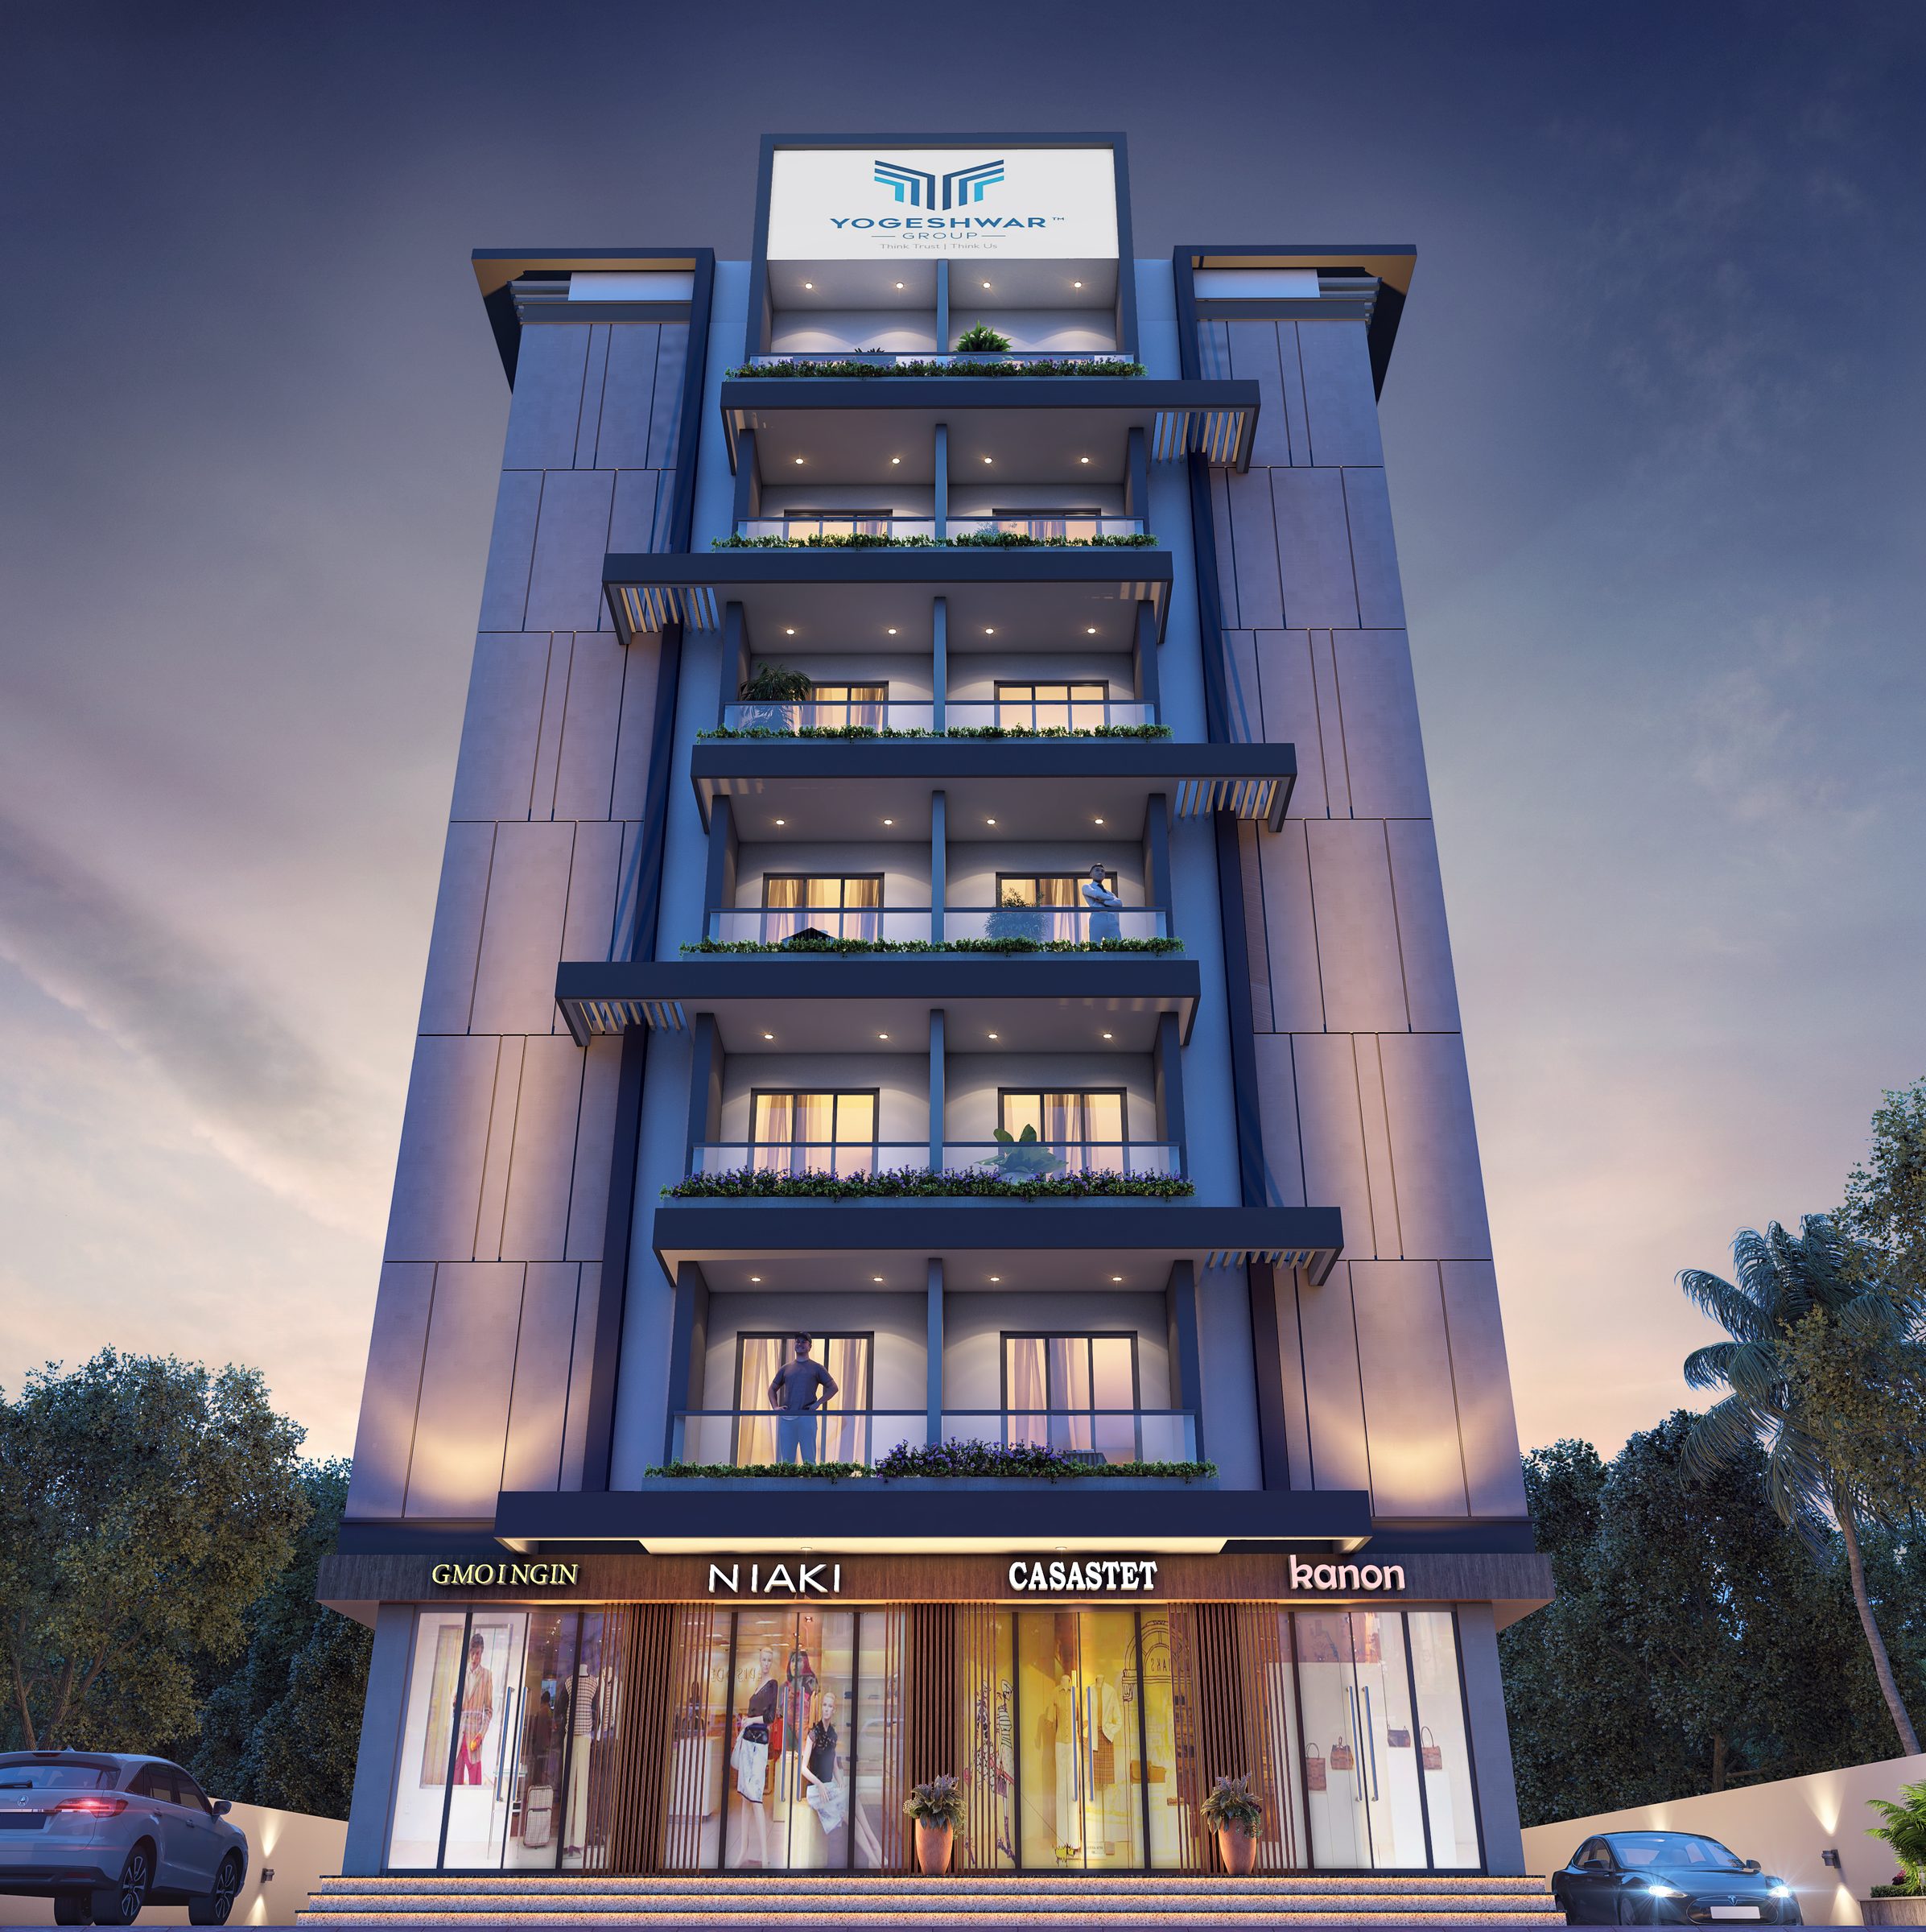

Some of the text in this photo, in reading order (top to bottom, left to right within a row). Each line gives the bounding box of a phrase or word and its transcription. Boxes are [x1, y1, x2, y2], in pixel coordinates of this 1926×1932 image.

[830, 217, 1046, 229] YOGESHWAR
[901, 232, 978, 240] GROUP
[431, 1563, 579, 1586] GMOINGIN
[708, 1563, 840, 1593] NIAKI
[1008, 1560, 1158, 1591] CASASTET
[1289, 1554, 1405, 1590] kanon
